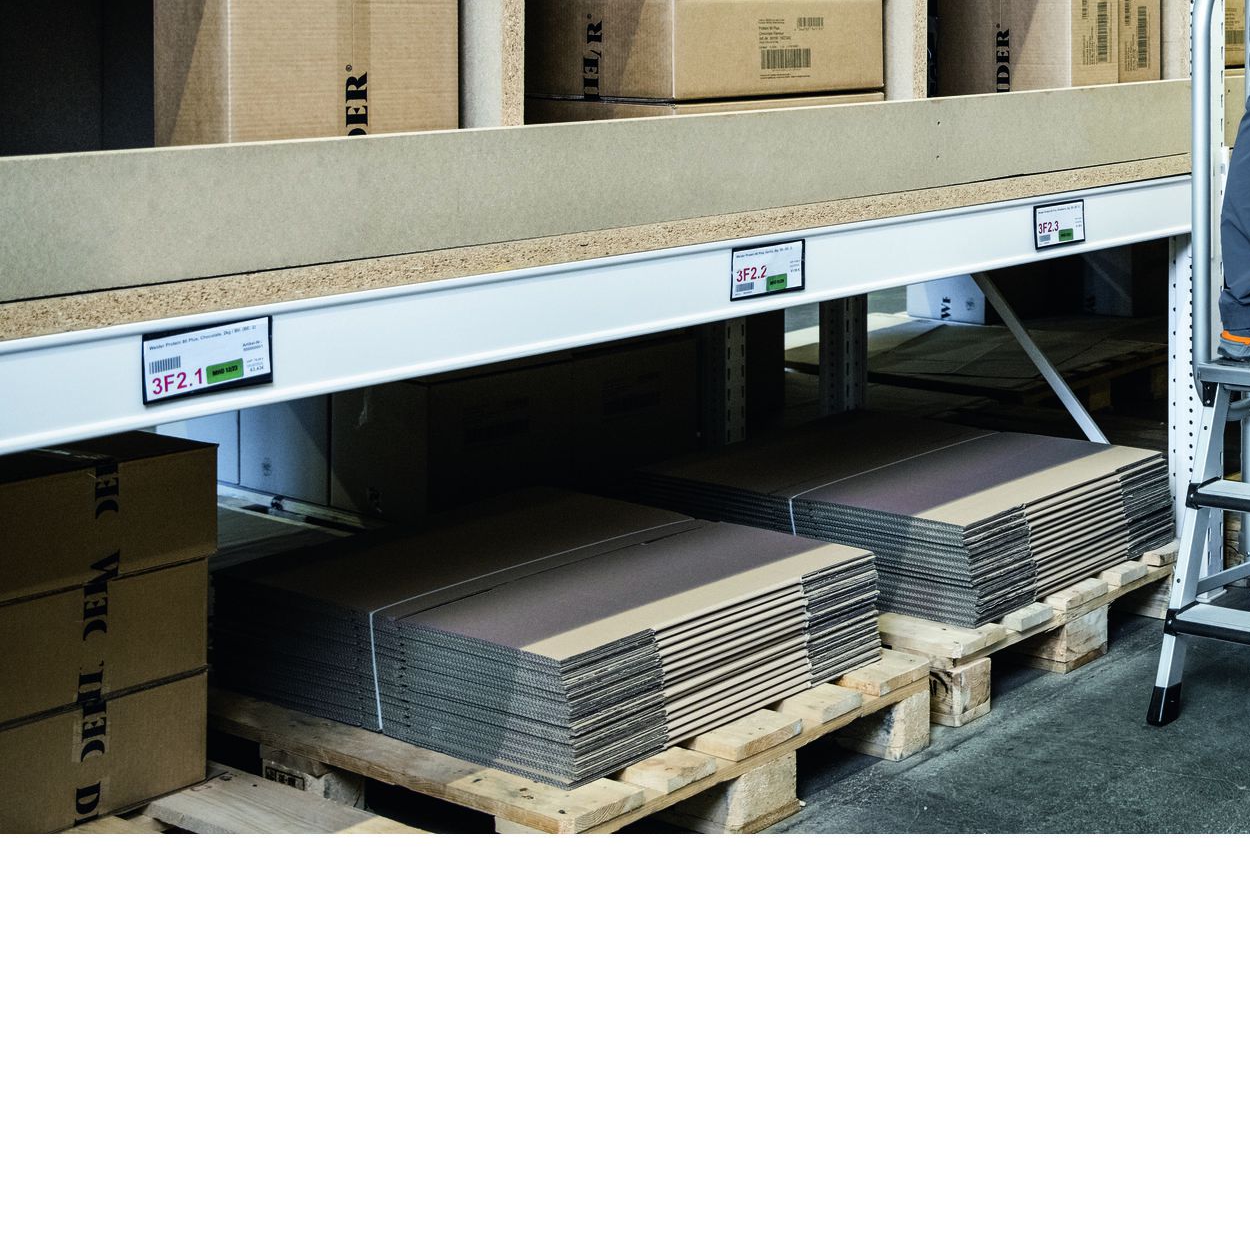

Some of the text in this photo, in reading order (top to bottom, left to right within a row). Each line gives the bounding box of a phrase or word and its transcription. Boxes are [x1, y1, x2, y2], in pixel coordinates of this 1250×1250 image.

[1038, 220, 1060, 235] 3F2.3
[736, 264, 768, 283] 3F2.2
[152, 367, 203, 396] 3F2.1
